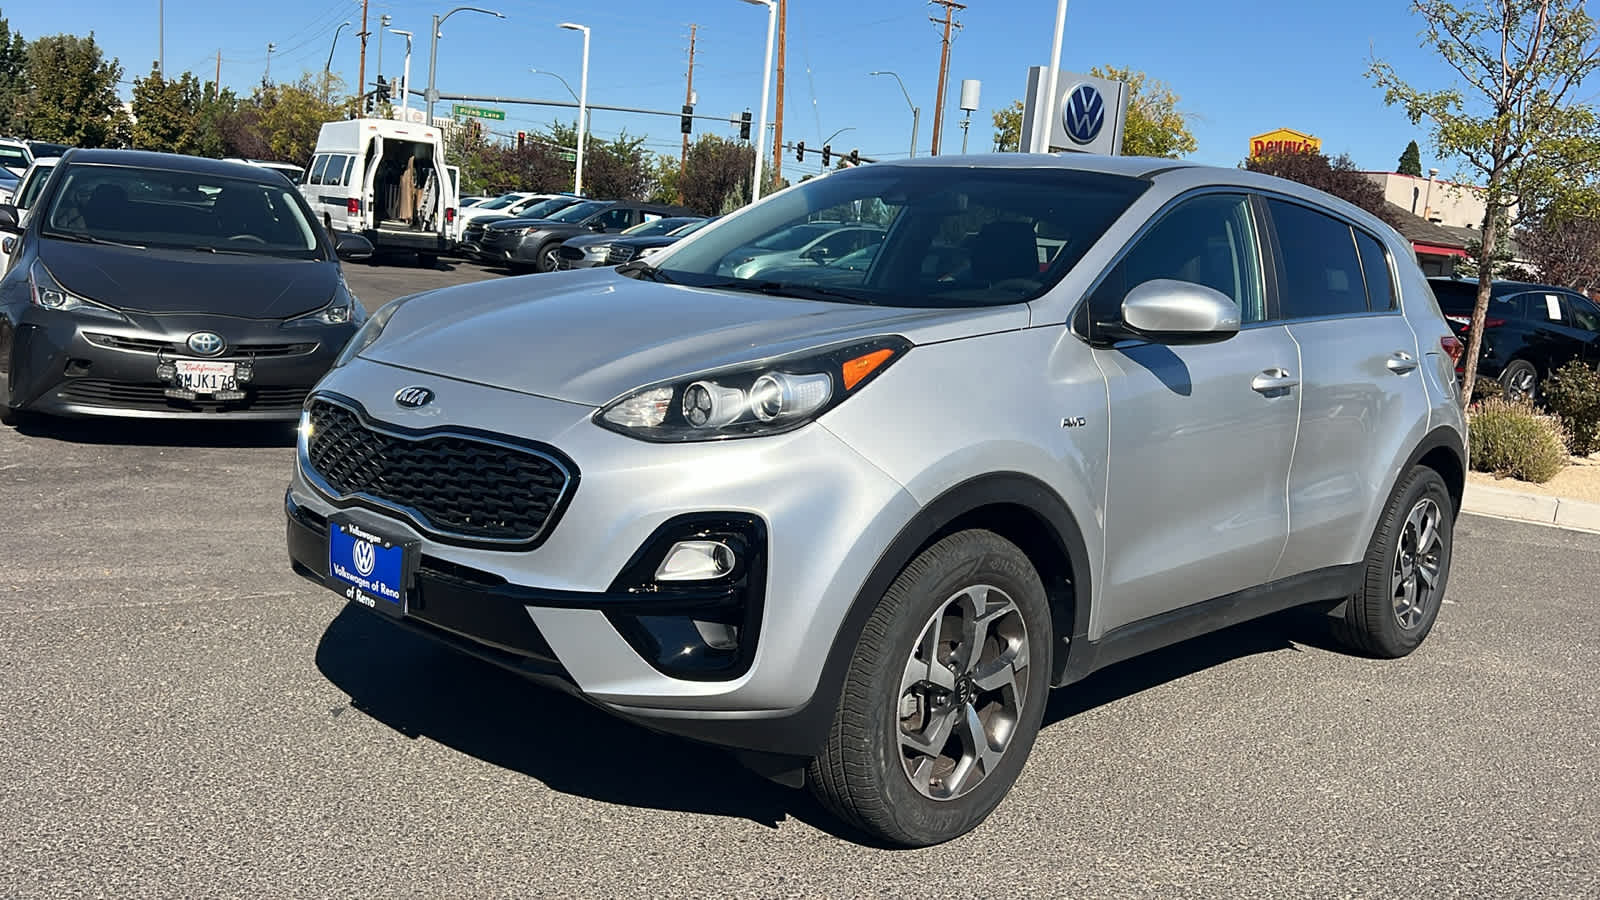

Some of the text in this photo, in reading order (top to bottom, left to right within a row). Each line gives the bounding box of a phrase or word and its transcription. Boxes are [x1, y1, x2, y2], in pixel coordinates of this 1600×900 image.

[483, 111, 500, 119] Lane
[1065, 85, 1105, 140] VW
[184, 363, 224, 374] California
[176, 373, 237, 389] 8MJK178
[398, 388, 429, 406] KIA
[1060, 416, 1087, 429] AWD
[348, 523, 382, 543] Volkswagen
[333, 562, 400, 599] Volkswagen of Reno
[346, 586, 376, 608] of Reno
